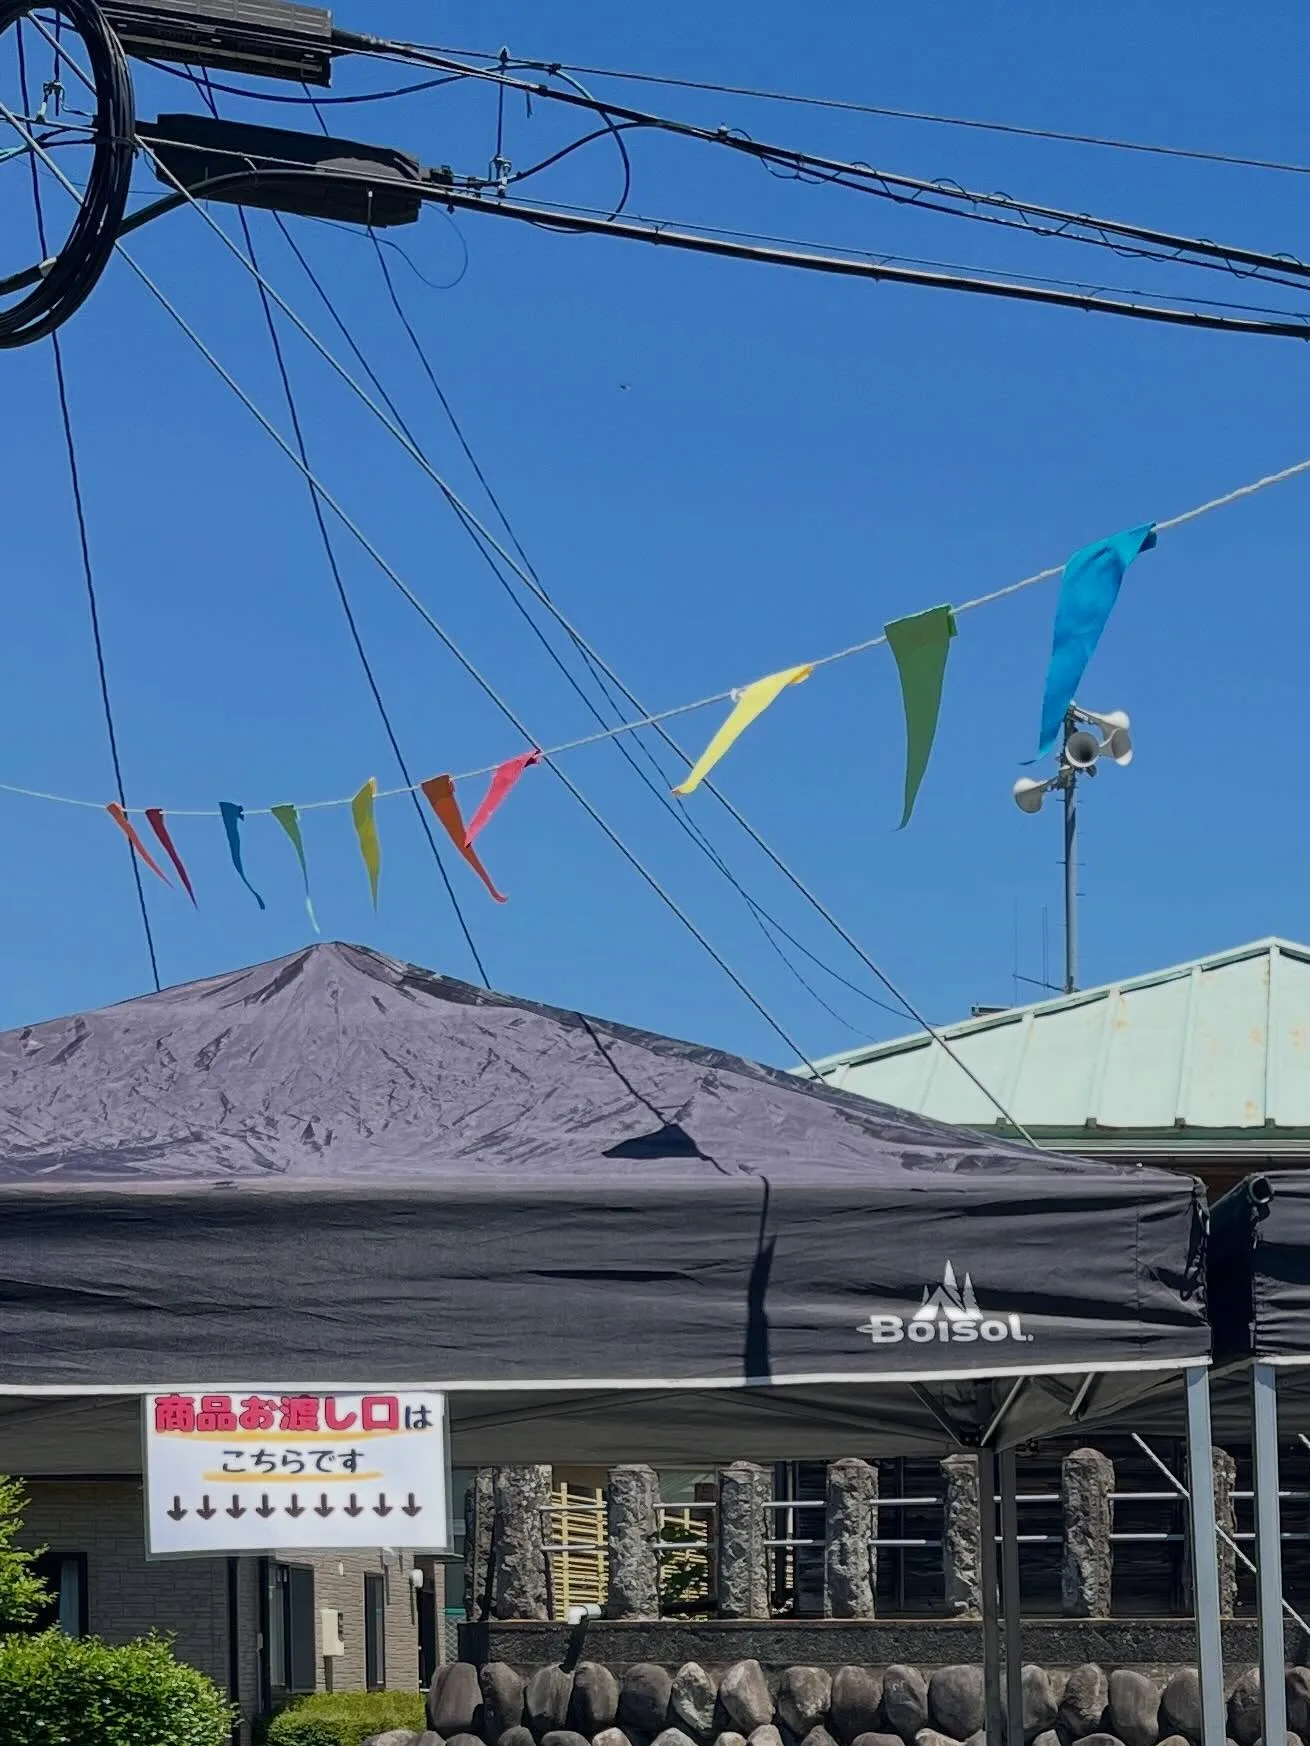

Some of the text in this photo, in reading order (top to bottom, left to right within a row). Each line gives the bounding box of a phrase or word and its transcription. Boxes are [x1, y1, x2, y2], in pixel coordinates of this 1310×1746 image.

[154, 1393, 433, 1432] 商品お渡し口は
[221, 1448, 365, 1474] こちらです
